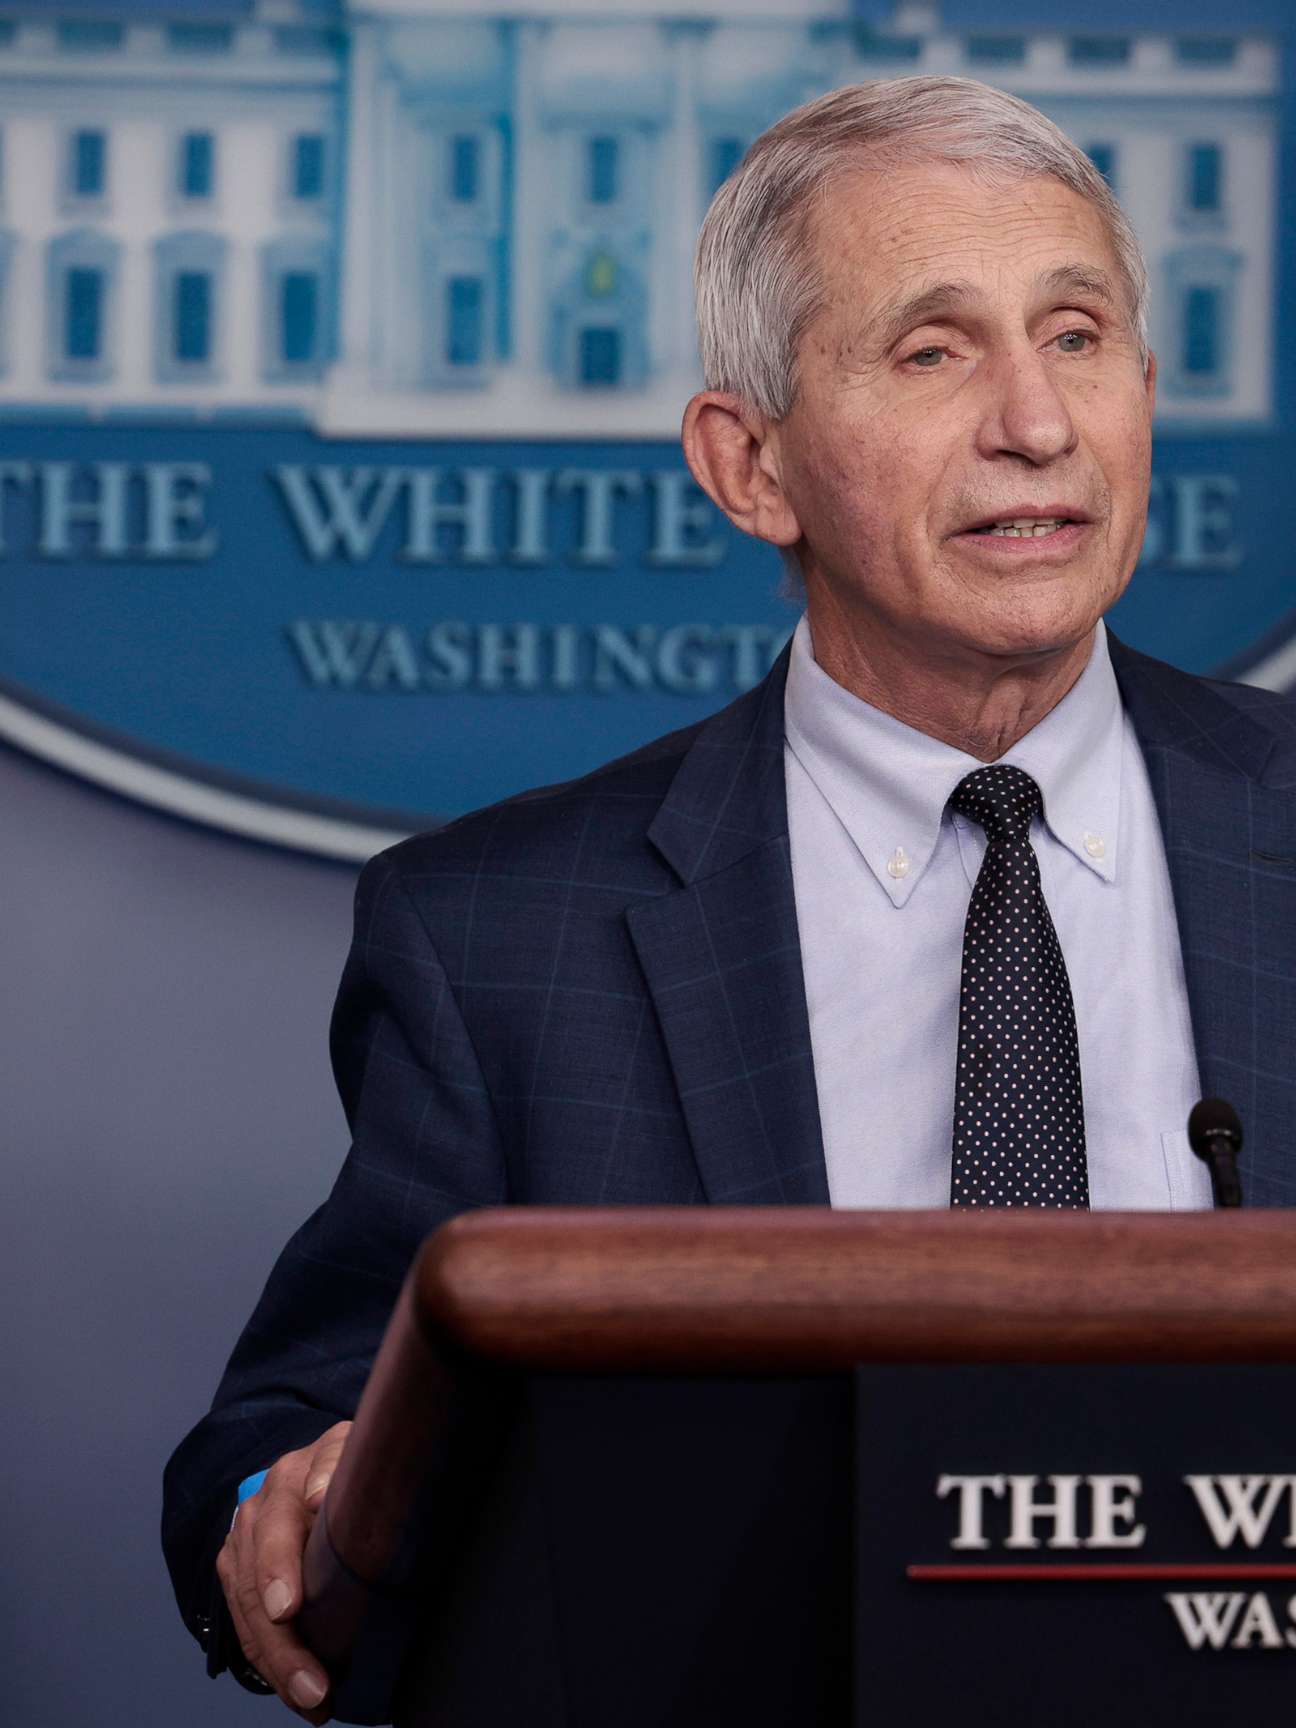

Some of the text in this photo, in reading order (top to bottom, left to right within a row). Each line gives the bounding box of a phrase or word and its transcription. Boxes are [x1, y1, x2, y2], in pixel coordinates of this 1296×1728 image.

[272, 464, 727, 566] WHITE
[289, 620, 791, 690] WASHINGT
[936, 1473, 1146, 1549] THE
